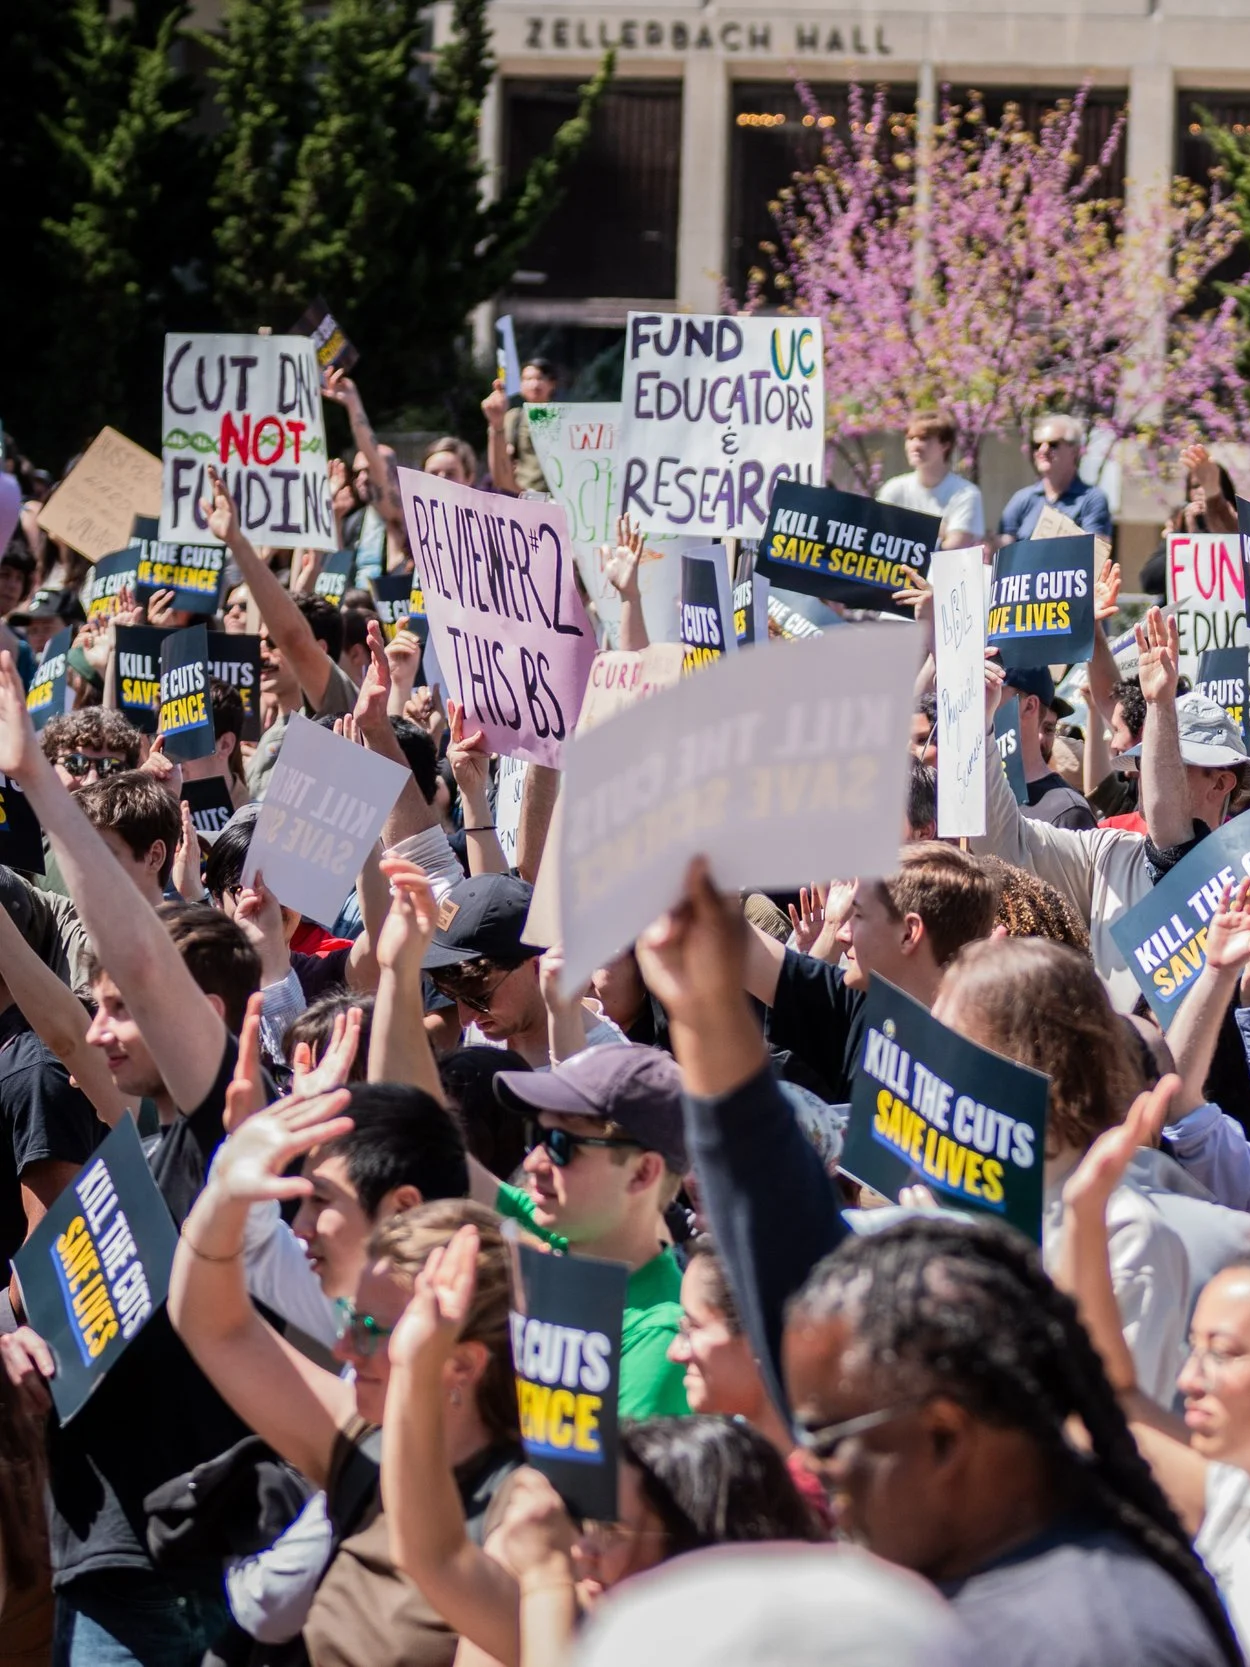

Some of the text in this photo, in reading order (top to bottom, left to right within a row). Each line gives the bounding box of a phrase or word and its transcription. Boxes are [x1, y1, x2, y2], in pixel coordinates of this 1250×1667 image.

[526, 18, 892, 54] ZELLERBACH HALL
[631, 316, 817, 381] FUND UC
[165, 340, 317, 420] CUT DN
[635, 370, 813, 430] EDUCATORS
[220, 411, 306, 466] NOT
[151, 543, 223, 570] THE CUTS
[413, 495, 552, 628] REVIEWER
[770, 534, 829, 567] SAVE
[773, 508, 927, 568] KILL THE CUTS
[105, 570, 136, 594] CUTS
[152, 565, 219, 592] SCIENCE
[315, 574, 345, 594] CUTS
[1000, 572, 1030, 601] THE
[1036, 569, 1087, 599] CUTS
[1171, 538, 1244, 602] FUN
[684, 604, 721, 646] CUTS
[1016, 601, 1070, 631] LIVES
[119, 652, 154, 680] KILL
[122, 679, 161, 705] SAVE
[169, 662, 205, 695] CUTS
[447, 626, 565, 741] THIS BS
[1209, 678, 1244, 704] CUTS
[1134, 913, 1194, 975] KILL
[1187, 866, 1239, 922] THE
[864, 1027, 1035, 1168] KILL THE CUTS
[874, 1089, 1005, 1203] SAVE LIVES
[75, 1158, 151, 1340] KILL THE CUTS
[57, 1215, 119, 1358] SAVE LIVES
[524, 1318, 611, 1392] CUTS
